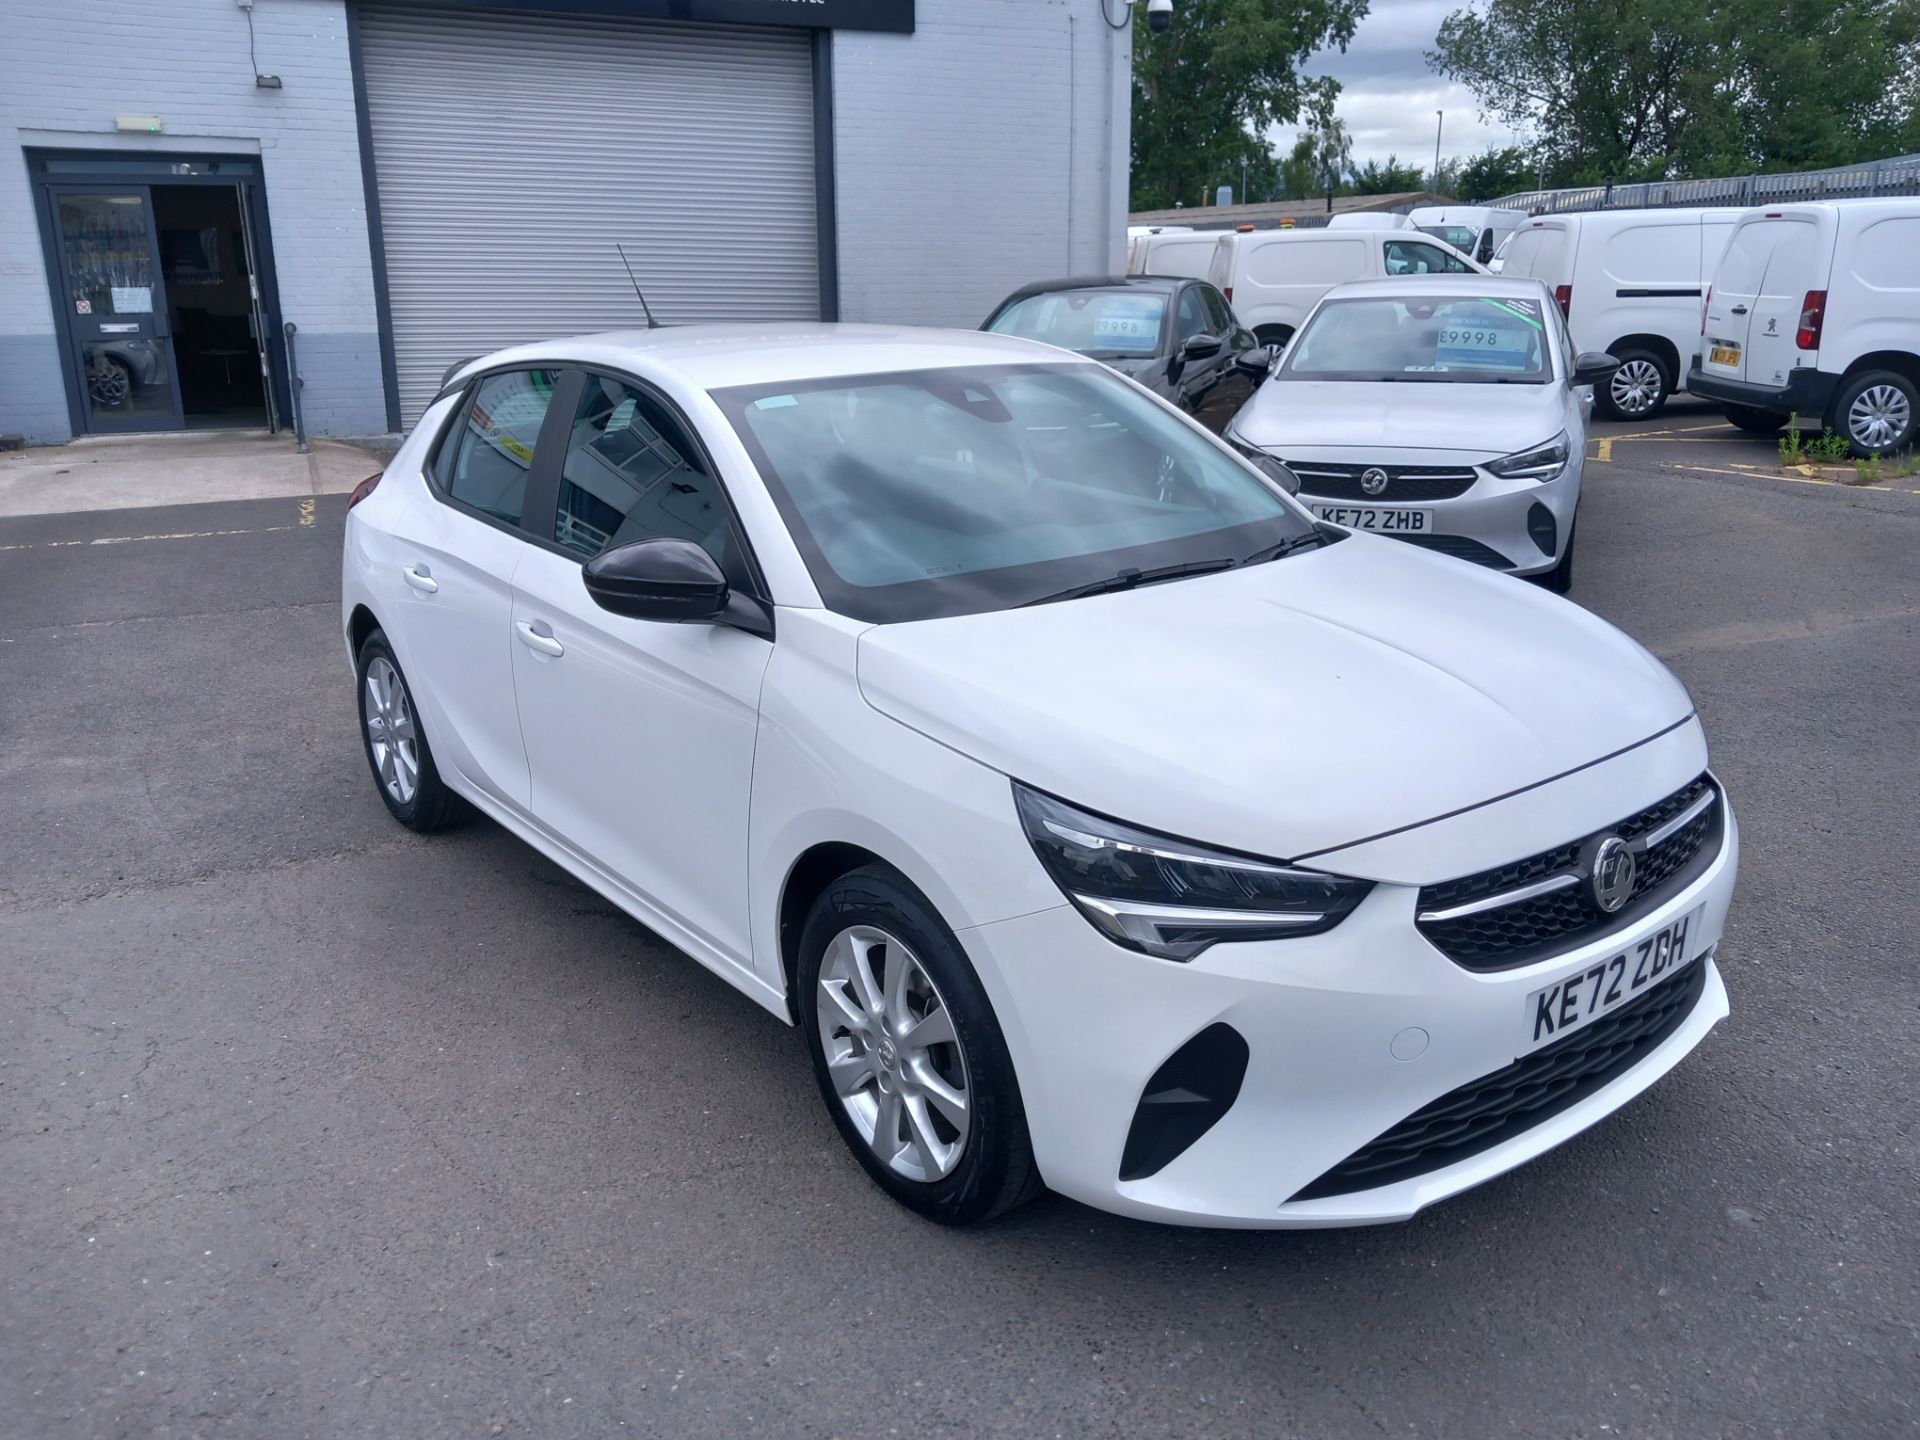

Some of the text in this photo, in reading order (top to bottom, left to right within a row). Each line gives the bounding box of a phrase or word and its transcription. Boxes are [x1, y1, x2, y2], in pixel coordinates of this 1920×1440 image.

[1439, 330, 1497, 346] £9998
[1321, 507, 1424, 530] KE72 ZHB
[1533, 954, 1627, 1042] KE72
